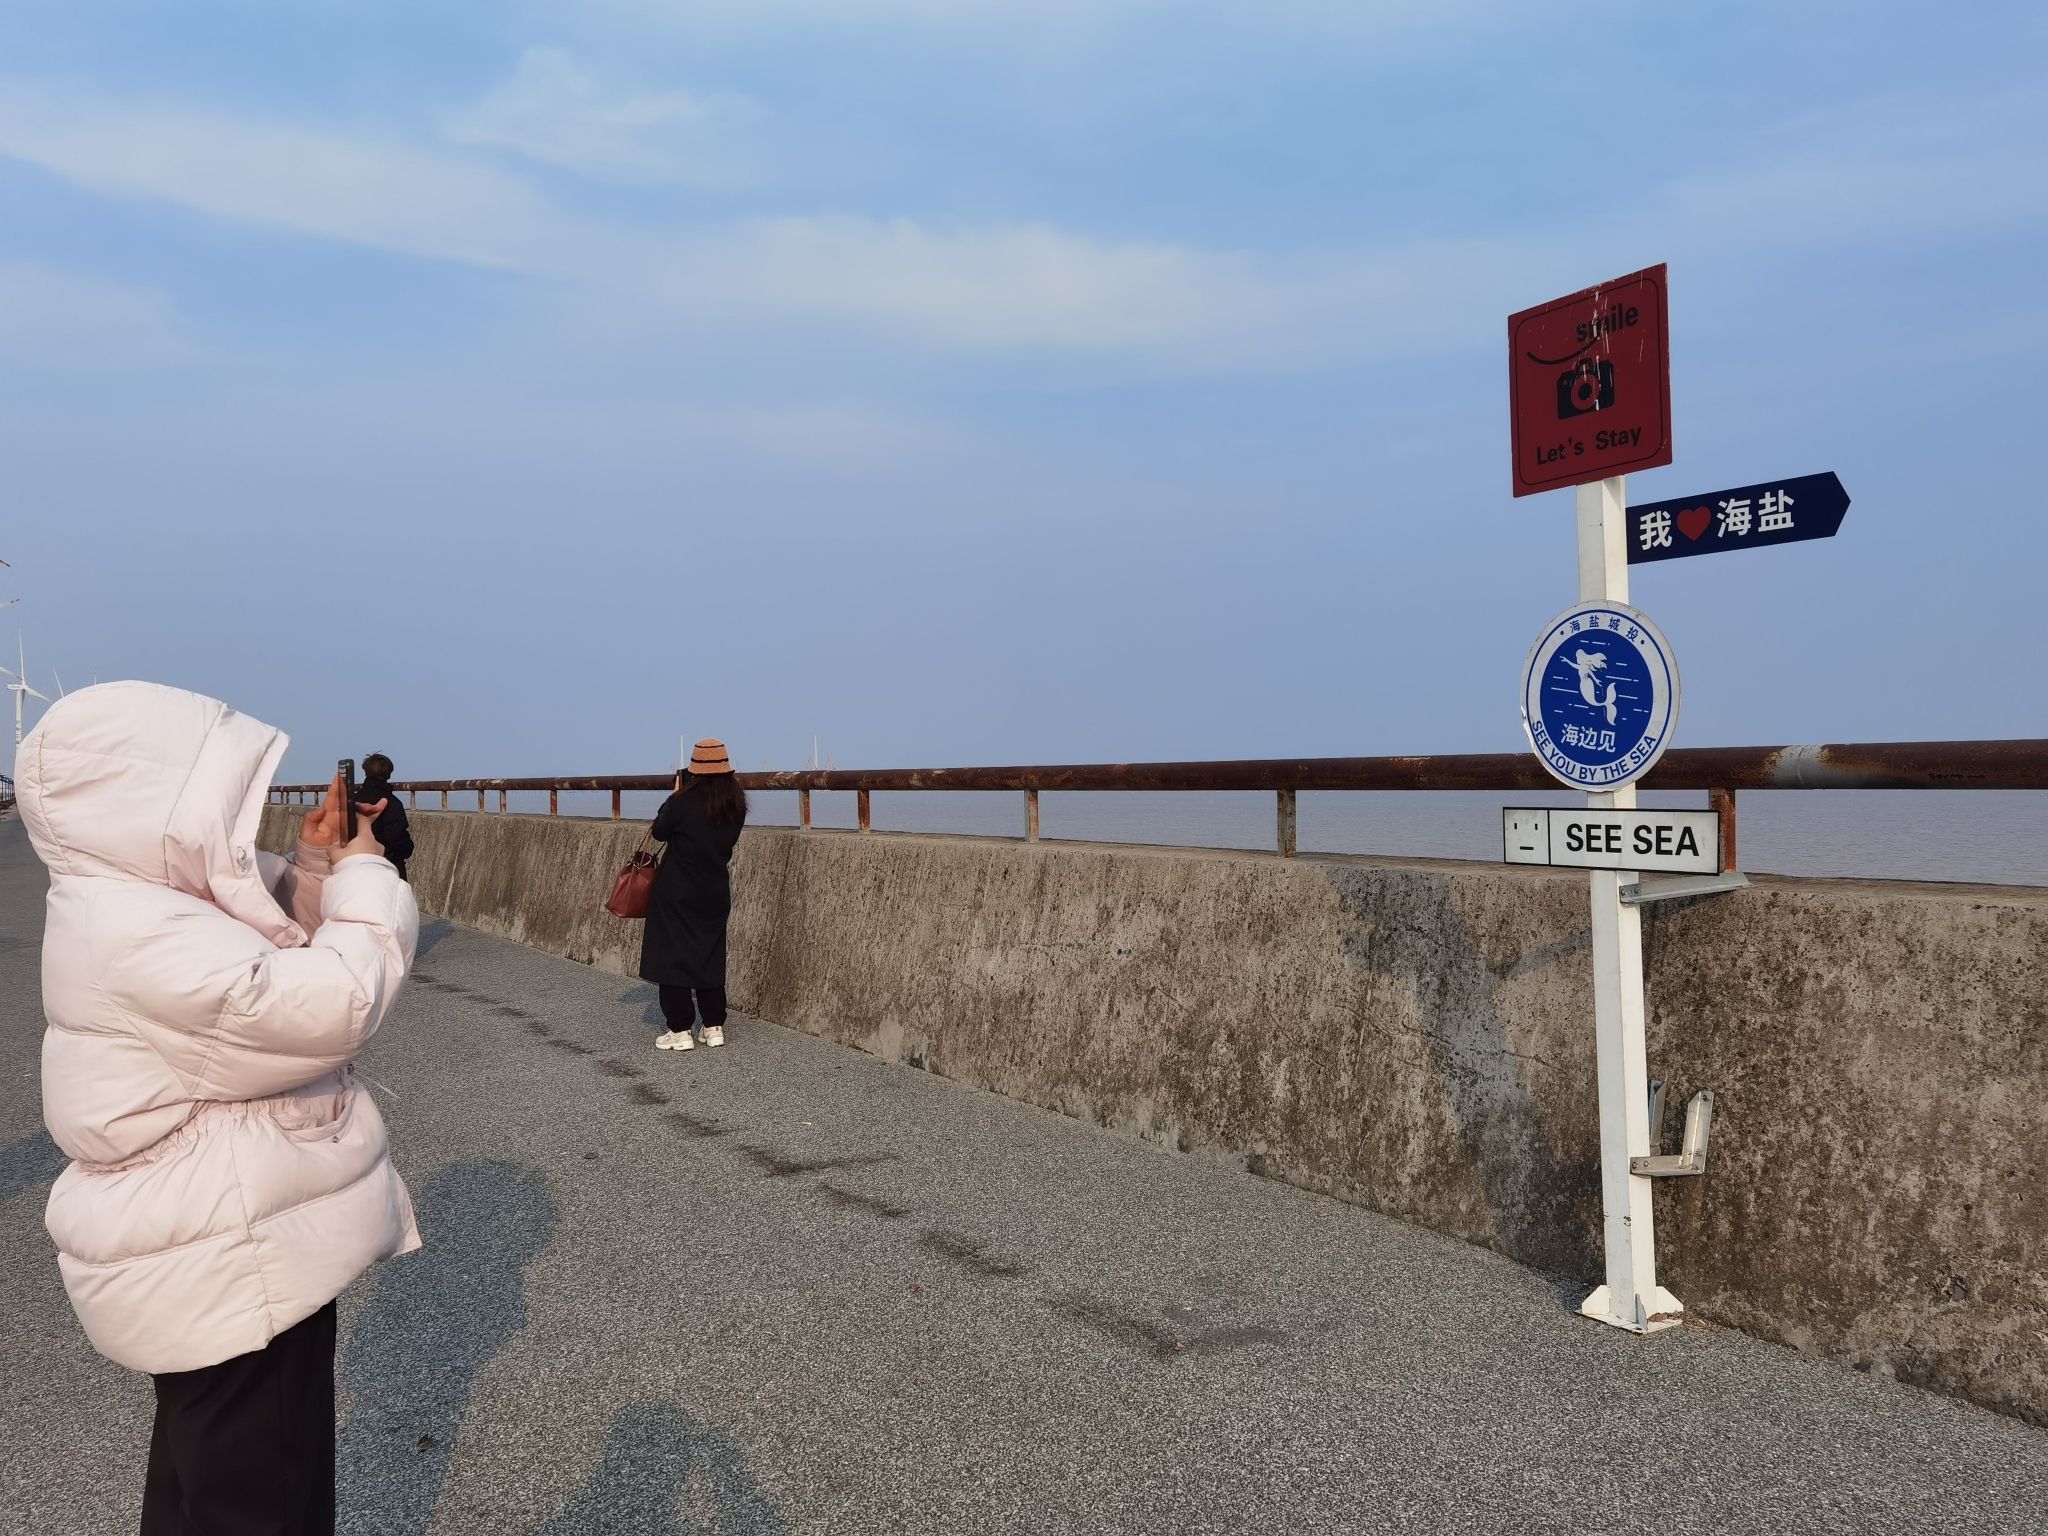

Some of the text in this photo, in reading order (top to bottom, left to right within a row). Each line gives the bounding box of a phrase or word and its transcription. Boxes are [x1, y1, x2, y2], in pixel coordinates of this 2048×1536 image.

[1576, 303, 1639, 342] smile
[1536, 426, 1642, 465] Let's Stay
[1569, 614, 1639, 642] 海盐城投
[1532, 720, 1657, 782] SEE YOU BY THE SEA
[1560, 722, 1616, 753] 海边见
[1566, 823, 1700, 857] SEE SEA
